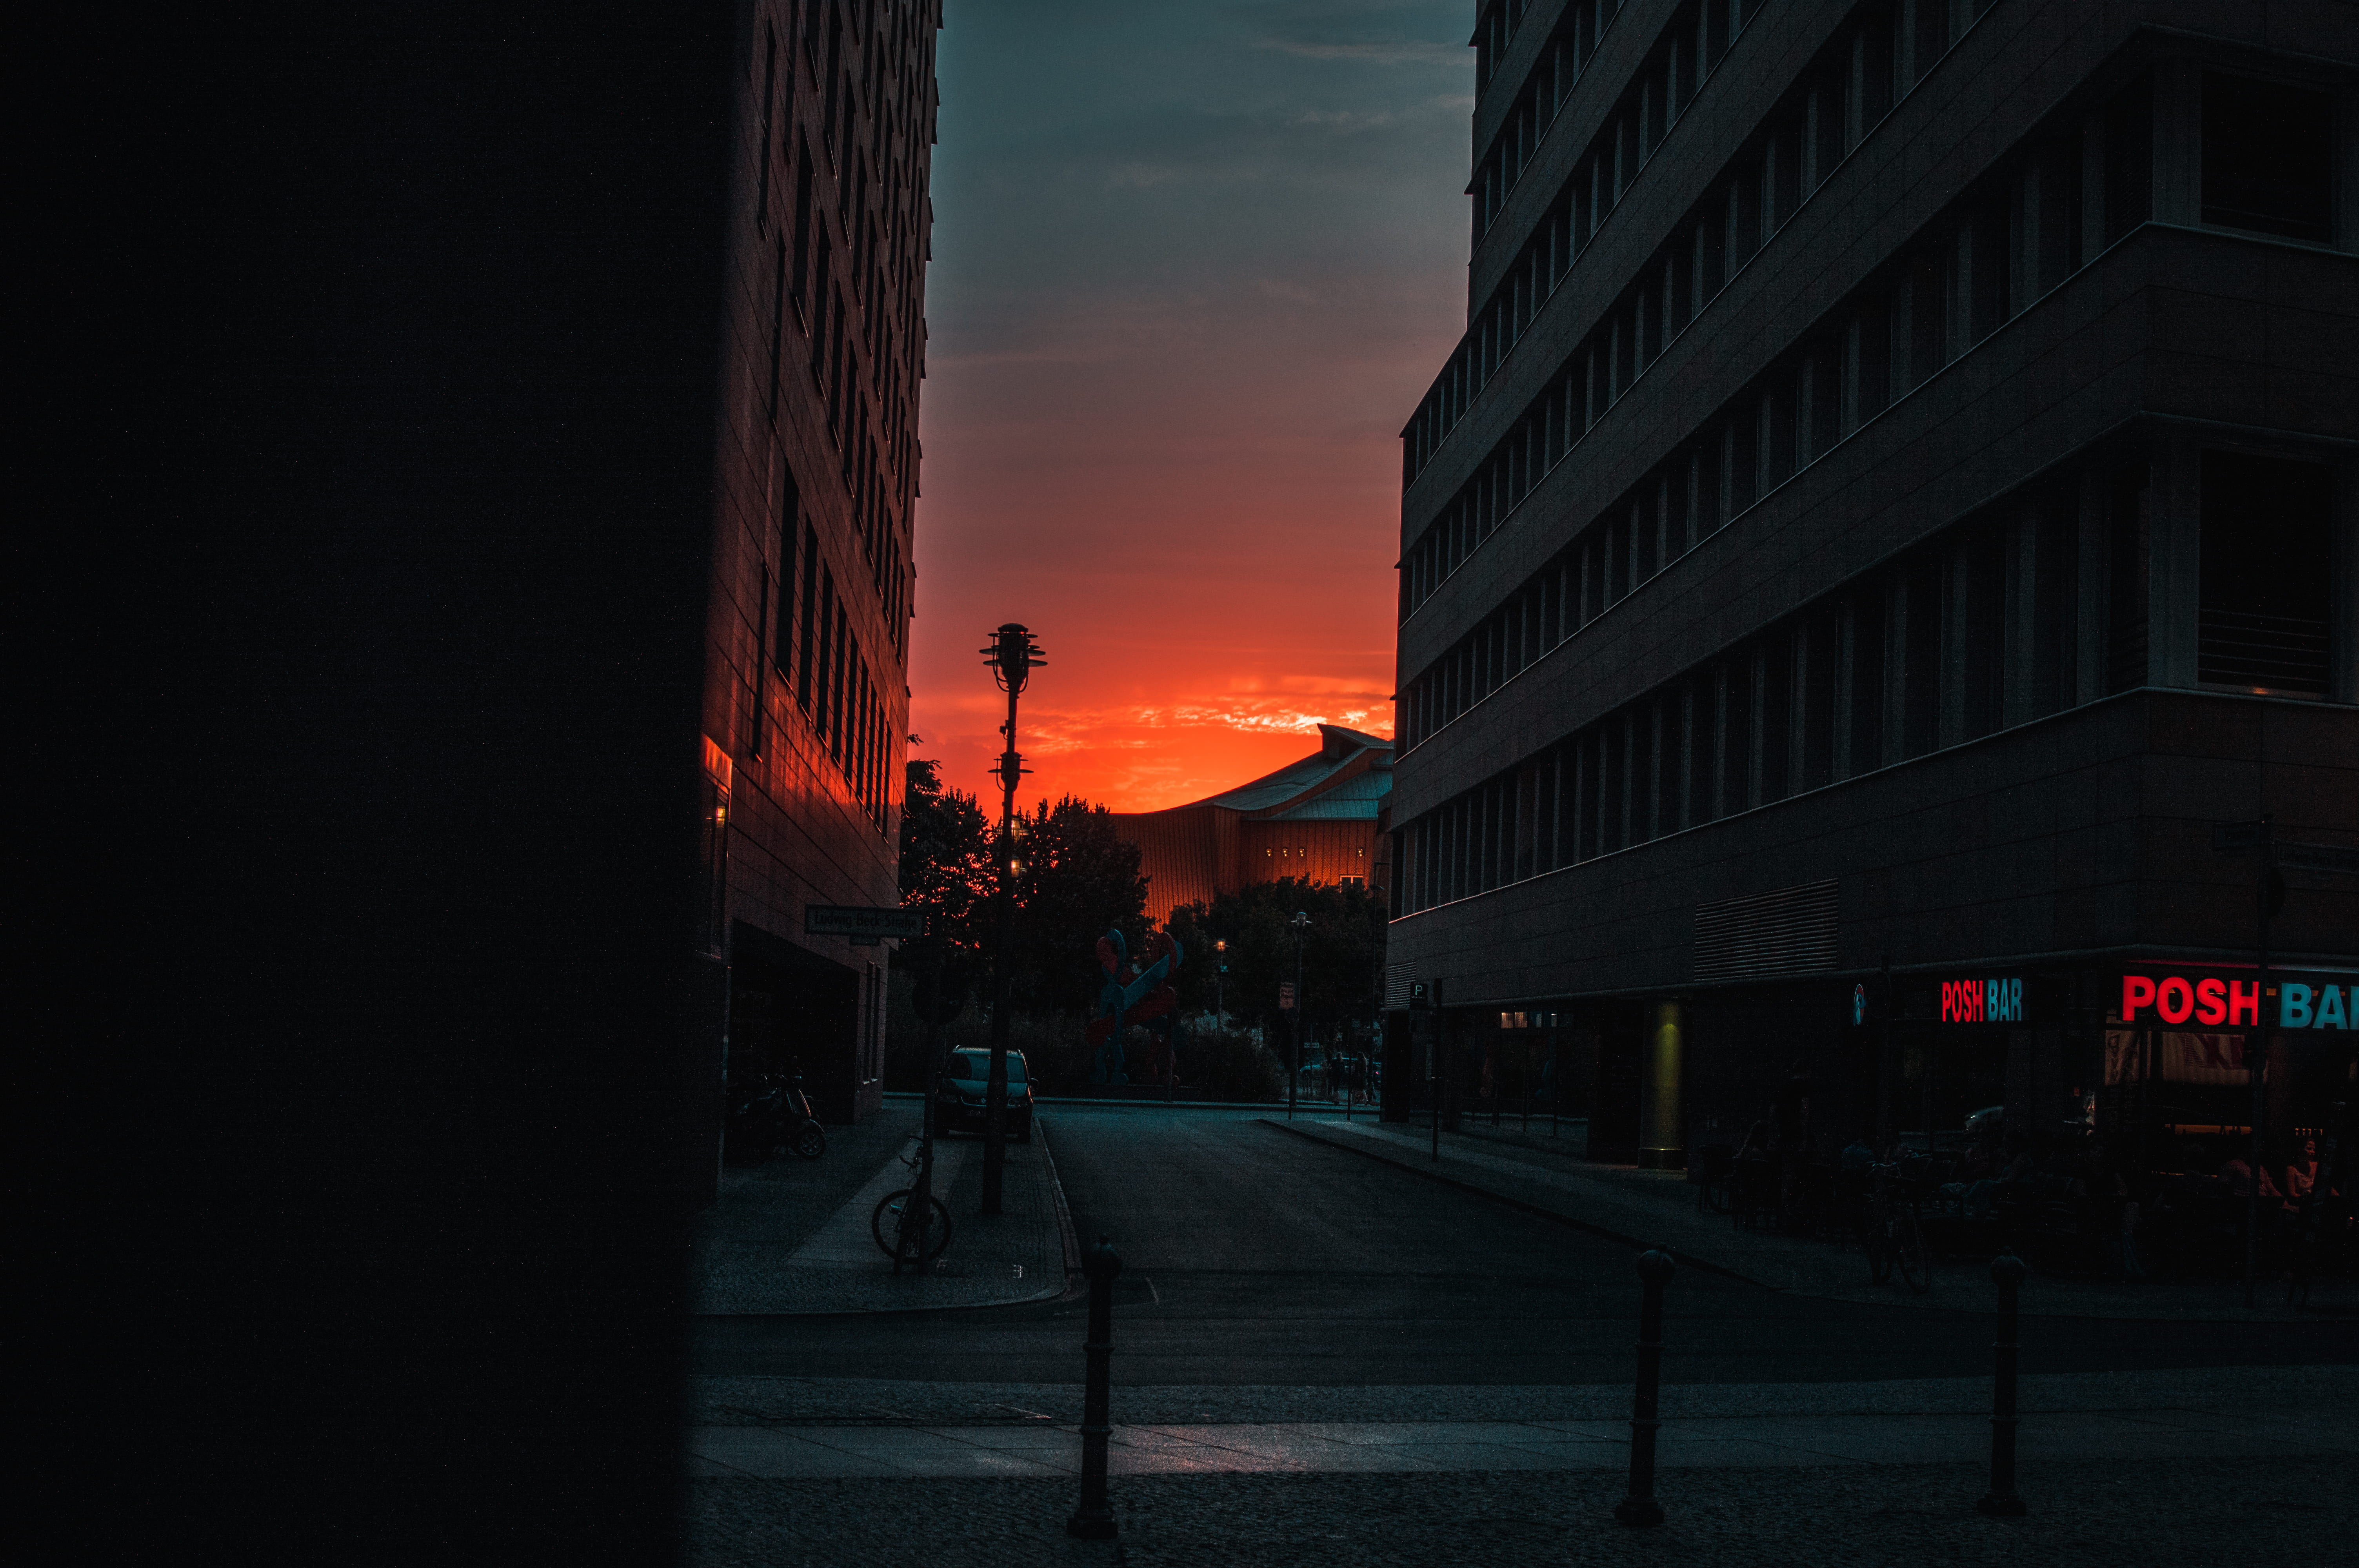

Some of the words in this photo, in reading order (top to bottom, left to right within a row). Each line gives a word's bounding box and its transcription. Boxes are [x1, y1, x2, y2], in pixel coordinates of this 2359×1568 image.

[814, 910, 917, 931] Ludwig-Beck-Straße
[1415, 984, 1423, 996] P
[1942, 979, 1983, 1023] POSH
[1987, 978, 2023, 1022] BAR
[2122, 975, 2260, 1027] POSH
[2280, 982, 2359, 1030] BA
